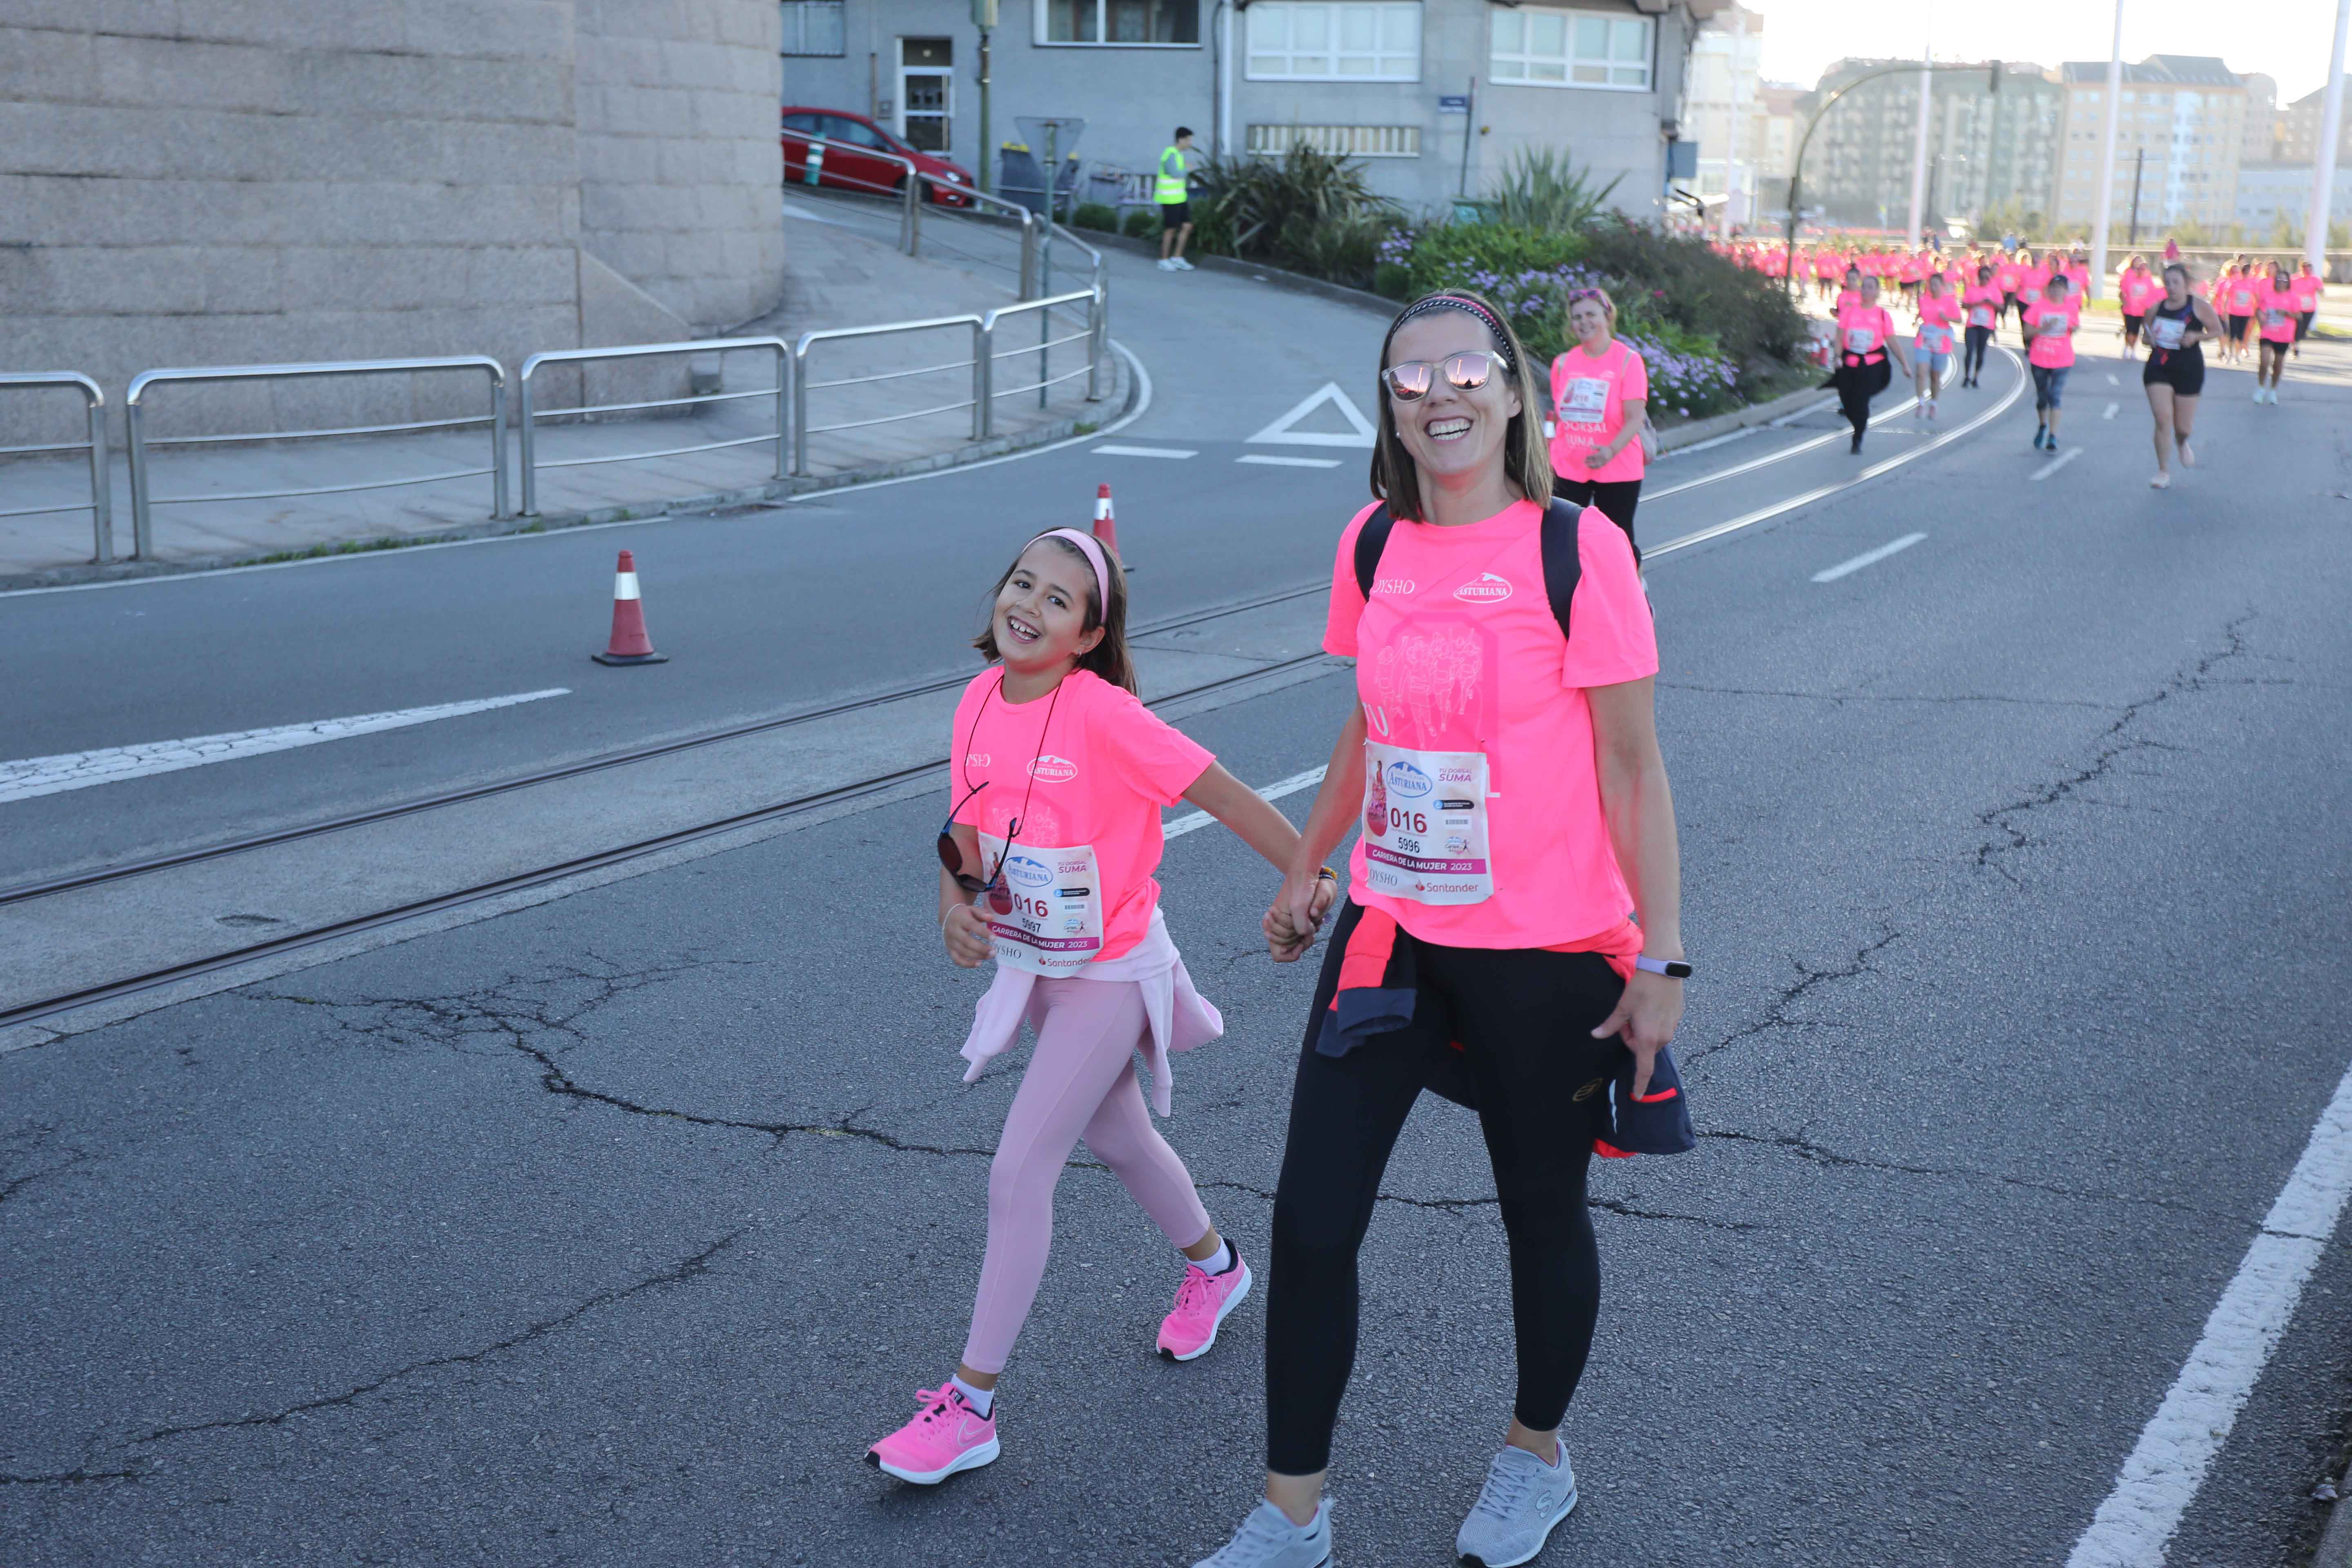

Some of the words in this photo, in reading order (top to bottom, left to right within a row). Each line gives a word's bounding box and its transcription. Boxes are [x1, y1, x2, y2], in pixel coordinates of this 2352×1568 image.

[1456, 587, 1508, 596] ASTURIANA
[1030, 763, 1074, 776] ASTURIANA
[1438, 773, 1472, 782] SUMA
[1389, 771, 1427, 791] ASTURIANA
[1390, 807, 1428, 833] 016
[1398, 837, 1420, 853] 5996
[1372, 849, 1398, 863] CARRERA
[1398, 857, 1406, 866] DE
[1407, 859, 1415, 869] LA
[1416, 862, 1447, 870] MUJER
[1450, 862, 1473, 871] 2023
[1007, 863, 1048, 882] ASTURIANA
[1369, 869, 1398, 886] OYSHO
[1426, 882, 1479, 892] Santander
[1014, 893, 1048, 917] 016
[992, 926, 1022, 939] CARRERA
[1023, 933, 1031, 942] DE
[1038, 940, 1065, 949] MUJER
[996, 944, 1022, 959] YSHO
[1047, 957, 1091, 967] Santander
